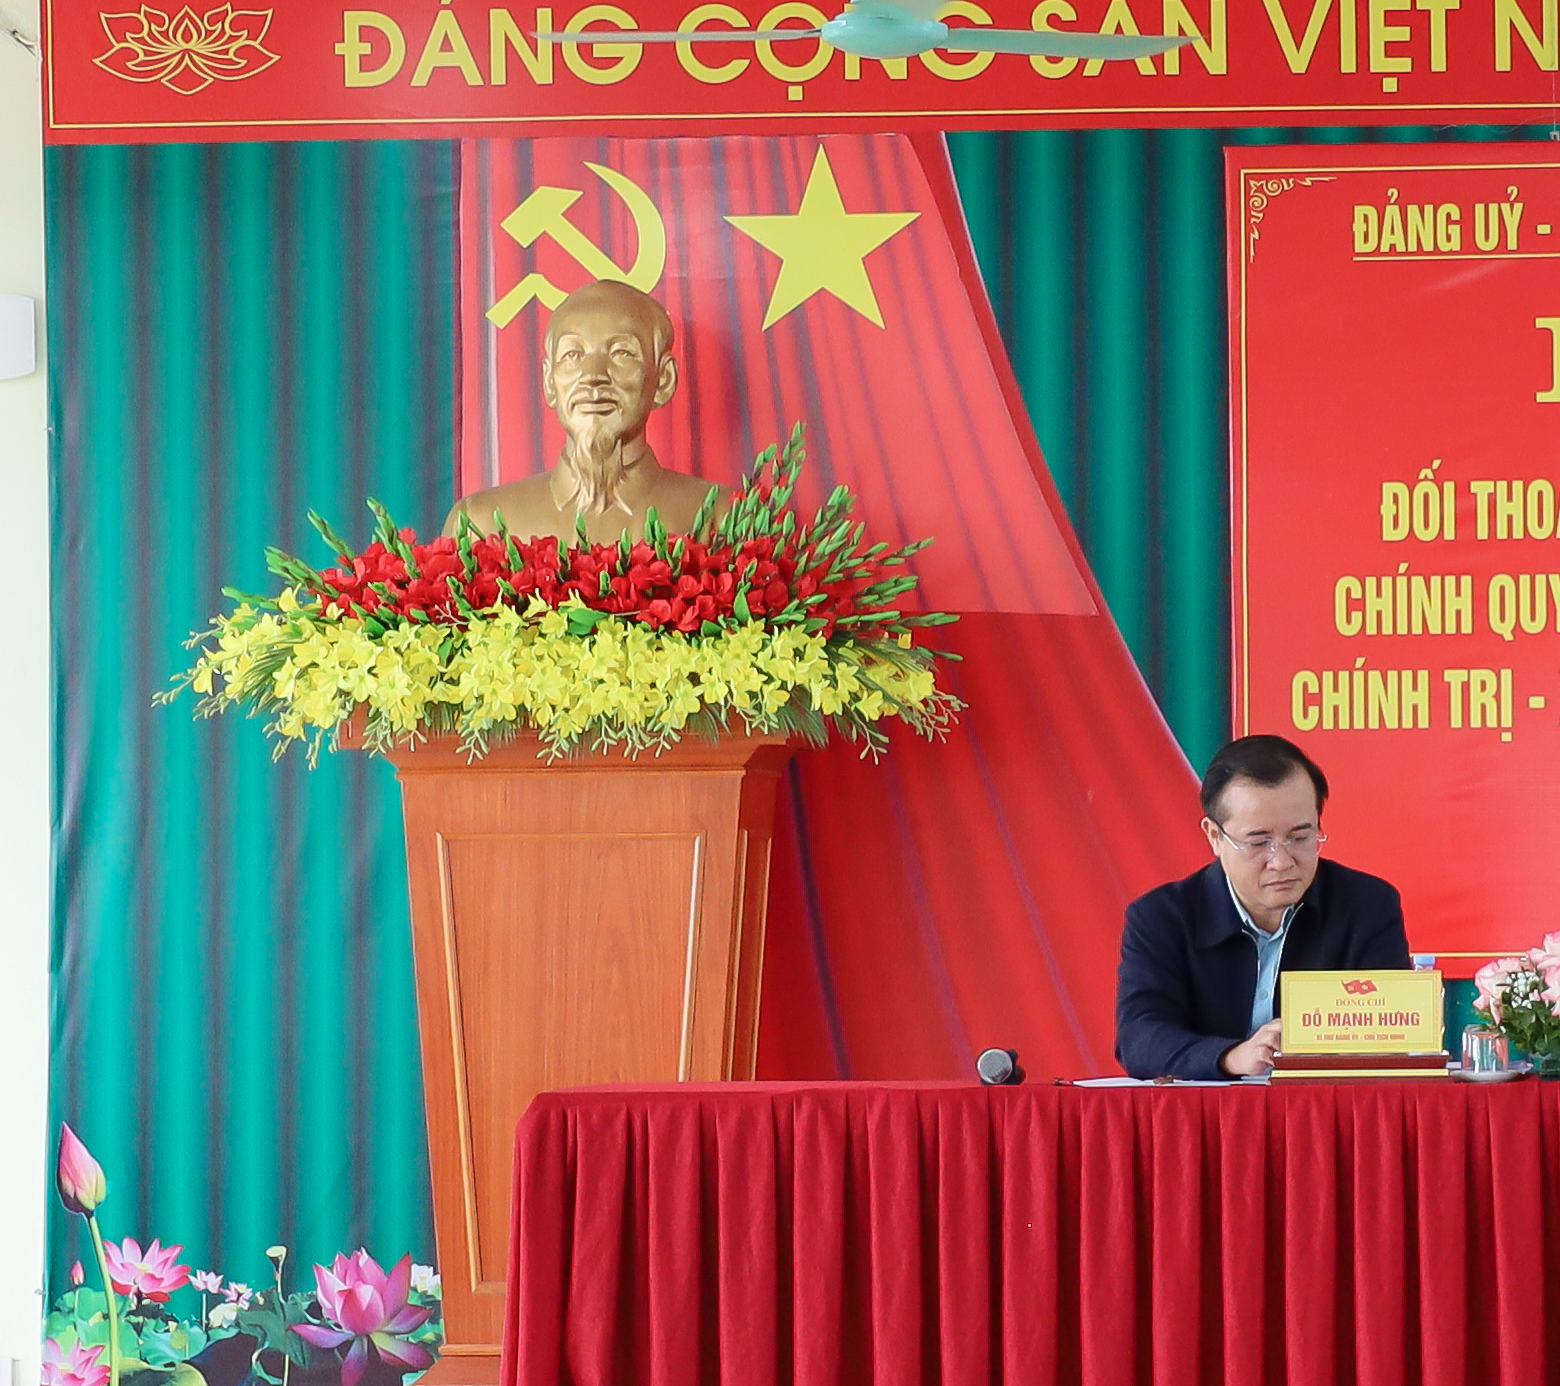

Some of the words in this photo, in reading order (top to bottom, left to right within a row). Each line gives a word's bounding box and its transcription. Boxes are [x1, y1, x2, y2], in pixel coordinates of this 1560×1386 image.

[1352, 188, 1460, 252] ĐẢNG
[1475, 185, 1523, 251] UỶ
[1538, 225, 1551, 234] -
[1381, 460, 1455, 541] ĐỐI
[1335, 563, 1472, 636] CHÍNH
[1292, 658, 1428, 730] CHÍNH
[1444, 669, 1512, 741] TRỊ
[1529, 696, 1544, 708] -
[1328, 1013, 1373, 1030] MẠNH
[1378, 1011, 1420, 1026] HƯNG
